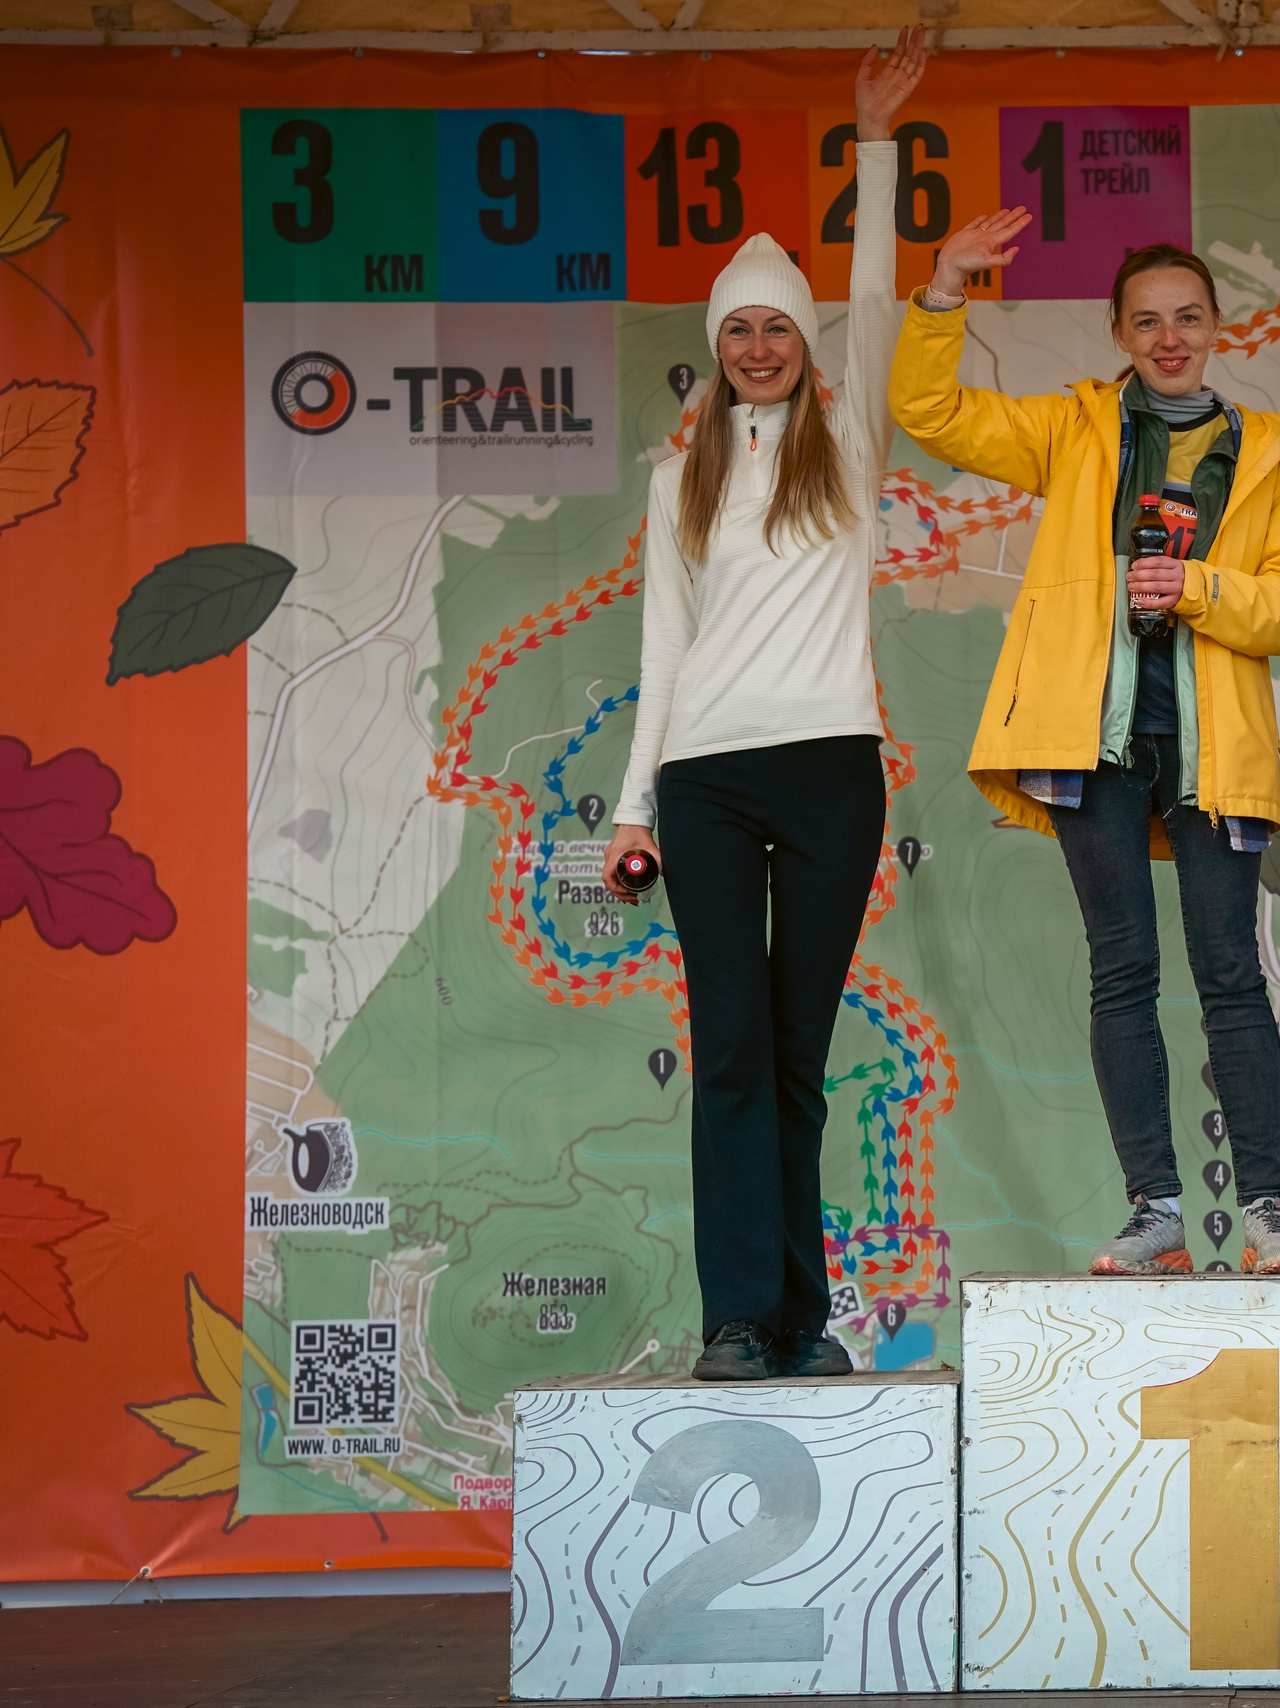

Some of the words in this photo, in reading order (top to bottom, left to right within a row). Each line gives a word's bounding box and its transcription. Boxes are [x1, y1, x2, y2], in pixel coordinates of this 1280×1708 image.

[1079, 123, 1182, 161] ДЕТСКИЙ
[271, 119, 334, 243] 3
[477, 121, 540, 246] 9
[637, 121, 744, 246] 13
[820, 121, 952, 244] 26
[1020, 121, 1066, 242] 1
[1080, 162, 1151, 195] ТРЕЙЛ
[364, 253, 424, 293] КМ
[556, 252, 611, 292] КМ
[678, 366, 690, 391] 3
[409, 434, 595, 448] orienteering&trailrunning&cycling
[588, 798, 599, 821] 2
[590, 911, 620, 936] 926
[658, 1051, 665, 1074] 1
[1213, 1113, 1223, 1136] 3
[1214, 1165, 1224, 1186] 4
[249, 1196, 386, 1230] Железноводск
[1213, 1213, 1223, 1236] 5
[502, 1272, 607, 1297] Железная
[887, 1303, 896, 1326] 6
[1140, 1348, 1280, 1671] 1
[617, 1419, 822, 1663] 2
